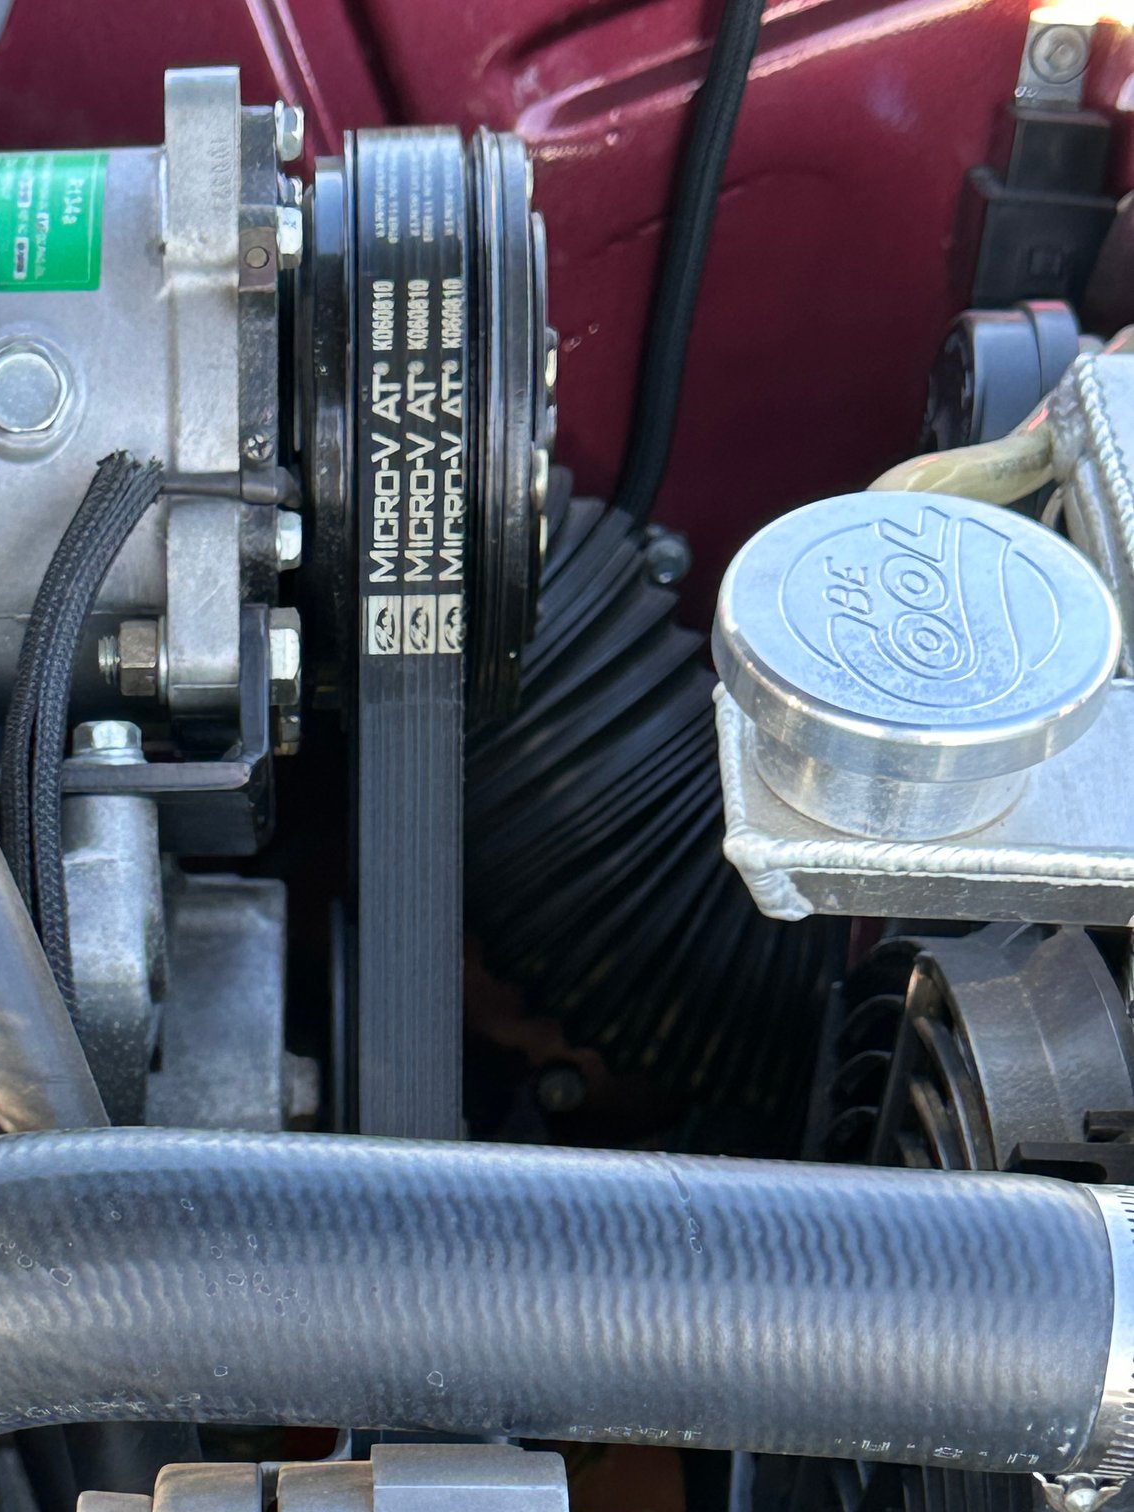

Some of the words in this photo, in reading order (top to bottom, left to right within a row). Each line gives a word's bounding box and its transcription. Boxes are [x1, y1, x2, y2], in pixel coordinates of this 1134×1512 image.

[369, 432, 401, 583] MICRO-V
[403, 432, 436, 582] MICRO-V
[822, 556, 874, 616] BE
[827, 505, 1022, 709] COOL
